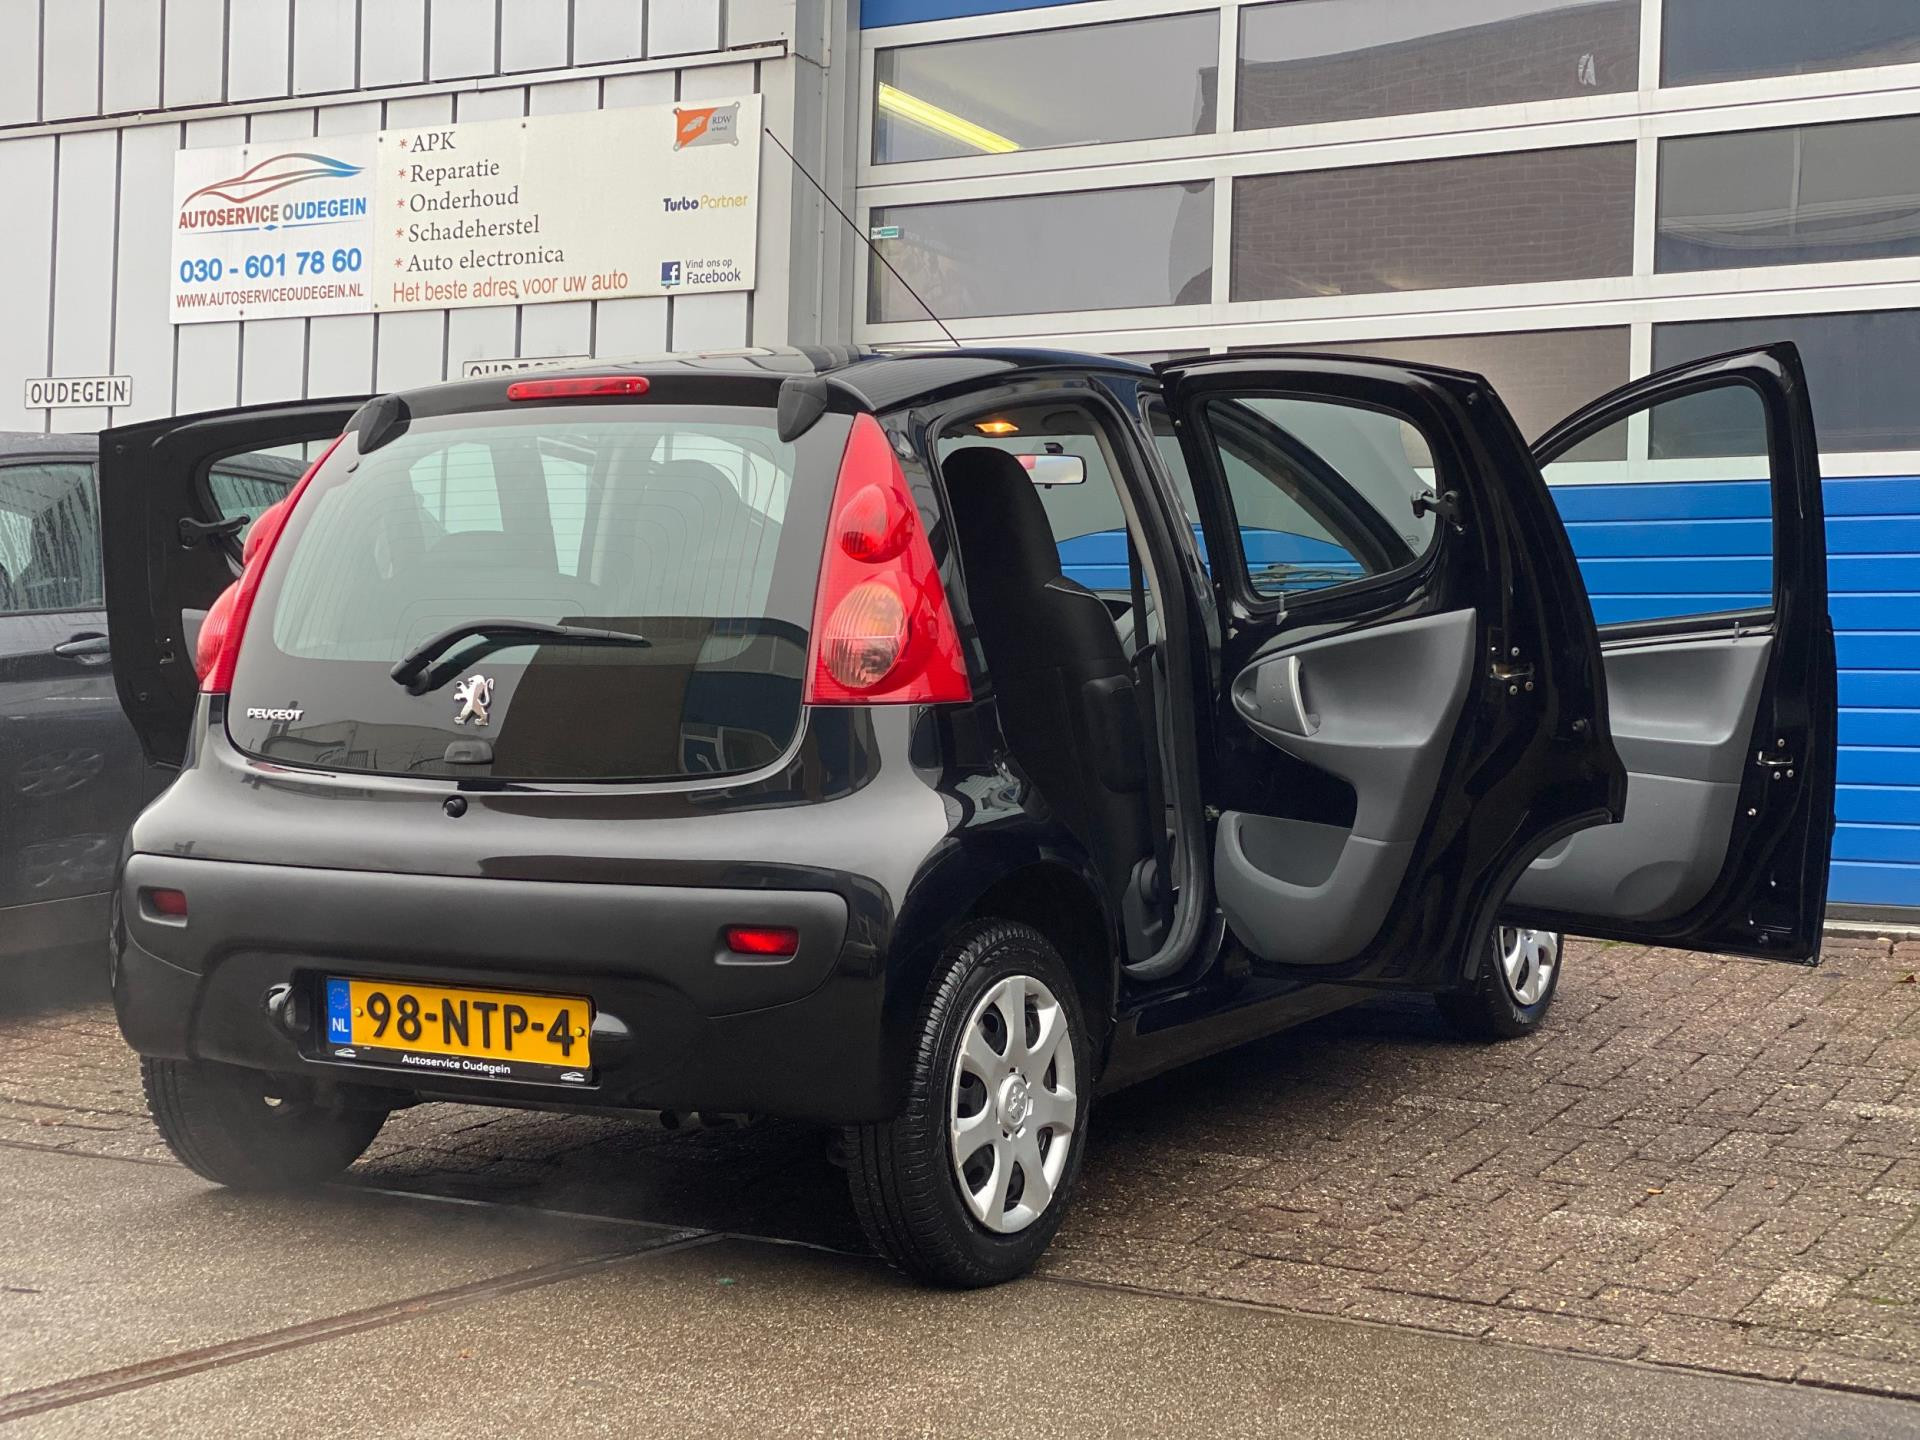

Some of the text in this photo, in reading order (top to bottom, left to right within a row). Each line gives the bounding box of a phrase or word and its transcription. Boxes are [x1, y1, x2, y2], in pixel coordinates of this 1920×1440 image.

[409, 131, 457, 153] APK
[409, 158, 501, 187] Reparatie
[408, 184, 520, 213] Onderhoud
[178, 197, 367, 230] AUTOSERVICE OUDEGEIN
[407, 213, 540, 243] Schadeherstel
[179, 258, 223, 284] 030
[244, 253, 286, 279] 601
[296, 250, 326, 275] 78
[331, 247, 363, 273] 60
[406, 245, 565, 273] Auto electronica
[685, 259, 733, 269] Vind ons op
[392, 268, 629, 304] Het beste adres voor uw auto
[686, 267, 742, 285] Facebook
[176, 283, 364, 308] WWW.AUTOSERVICEOUDEGEIN.NL
[31, 380, 125, 404] OUDEGEIN
[247, 707, 304, 721] PEUGEOT
[332, 1017, 349, 1033] NL
[366, 991, 575, 1057] 98-NTP-4
[401, 1053, 512, 1075] Autoservice Oudegein
